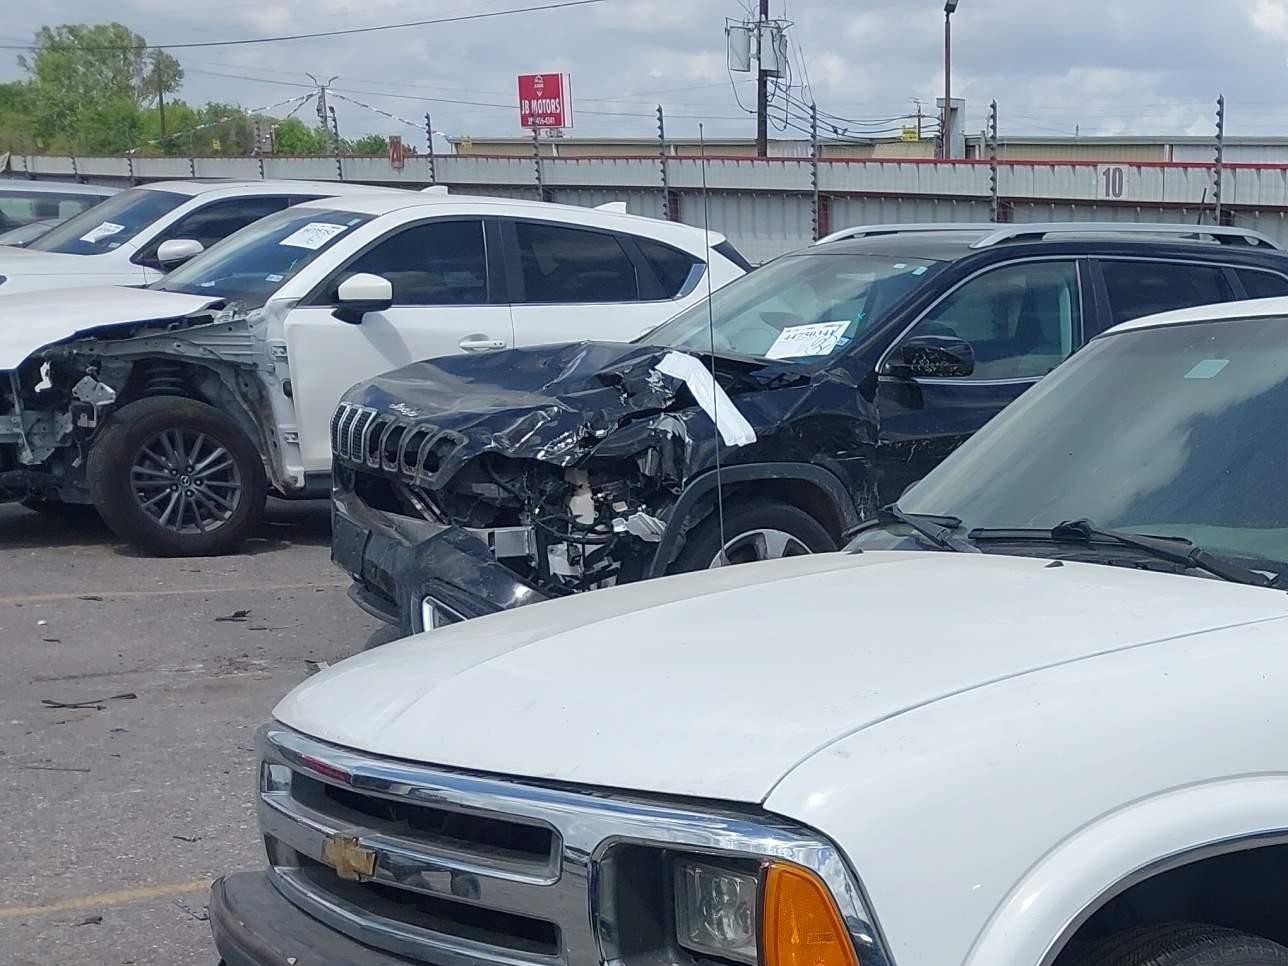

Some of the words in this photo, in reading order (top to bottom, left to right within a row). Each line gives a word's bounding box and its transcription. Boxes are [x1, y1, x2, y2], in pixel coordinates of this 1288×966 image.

[522, 99, 530, 115] JB
[531, 98, 560, 114] MOTORS
[1102, 167, 1124, 198] 10
